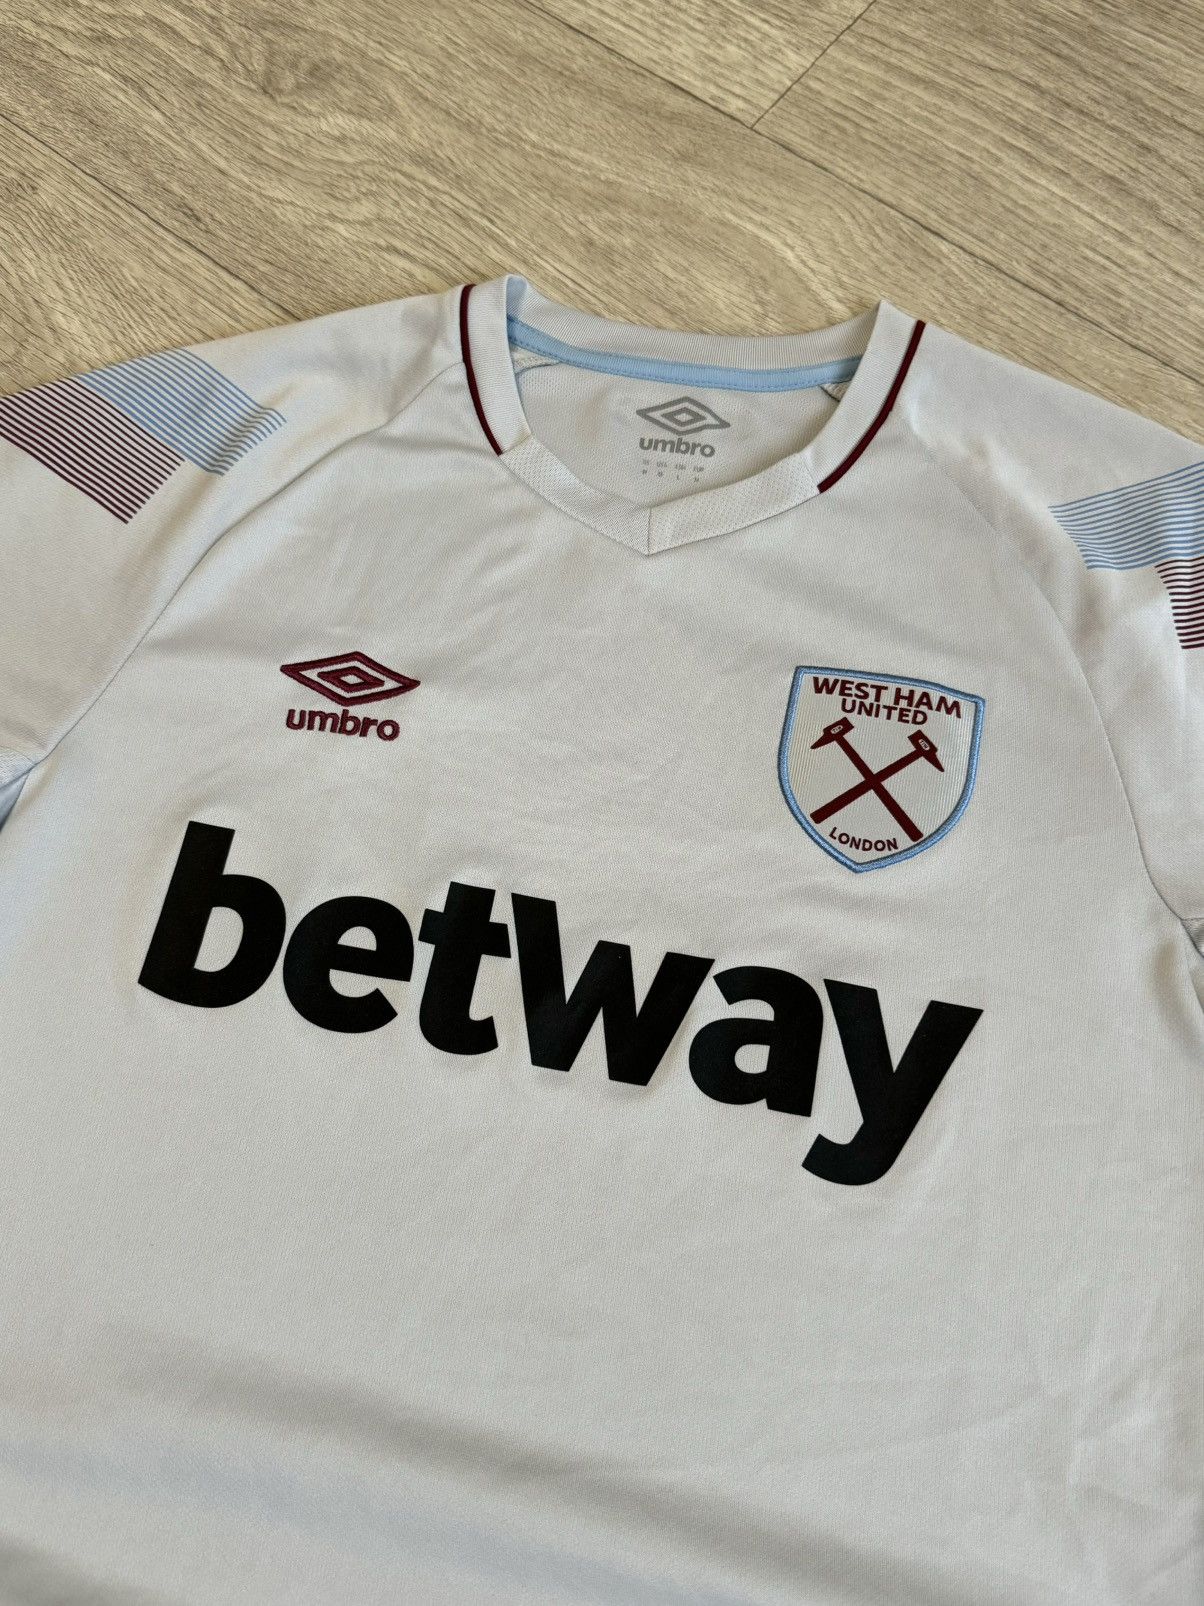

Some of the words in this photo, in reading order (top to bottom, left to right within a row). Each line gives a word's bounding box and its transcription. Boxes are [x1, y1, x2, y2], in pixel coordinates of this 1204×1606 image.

[639, 437, 716, 458] umbro
[813, 676, 888, 703] WEST
[893, 687, 962, 719] HAM
[841, 698, 928, 725] UNITED
[286, 708, 401, 742] umbro
[829, 827, 899, 852] LONDON
[138, 820, 984, 1187] betway
